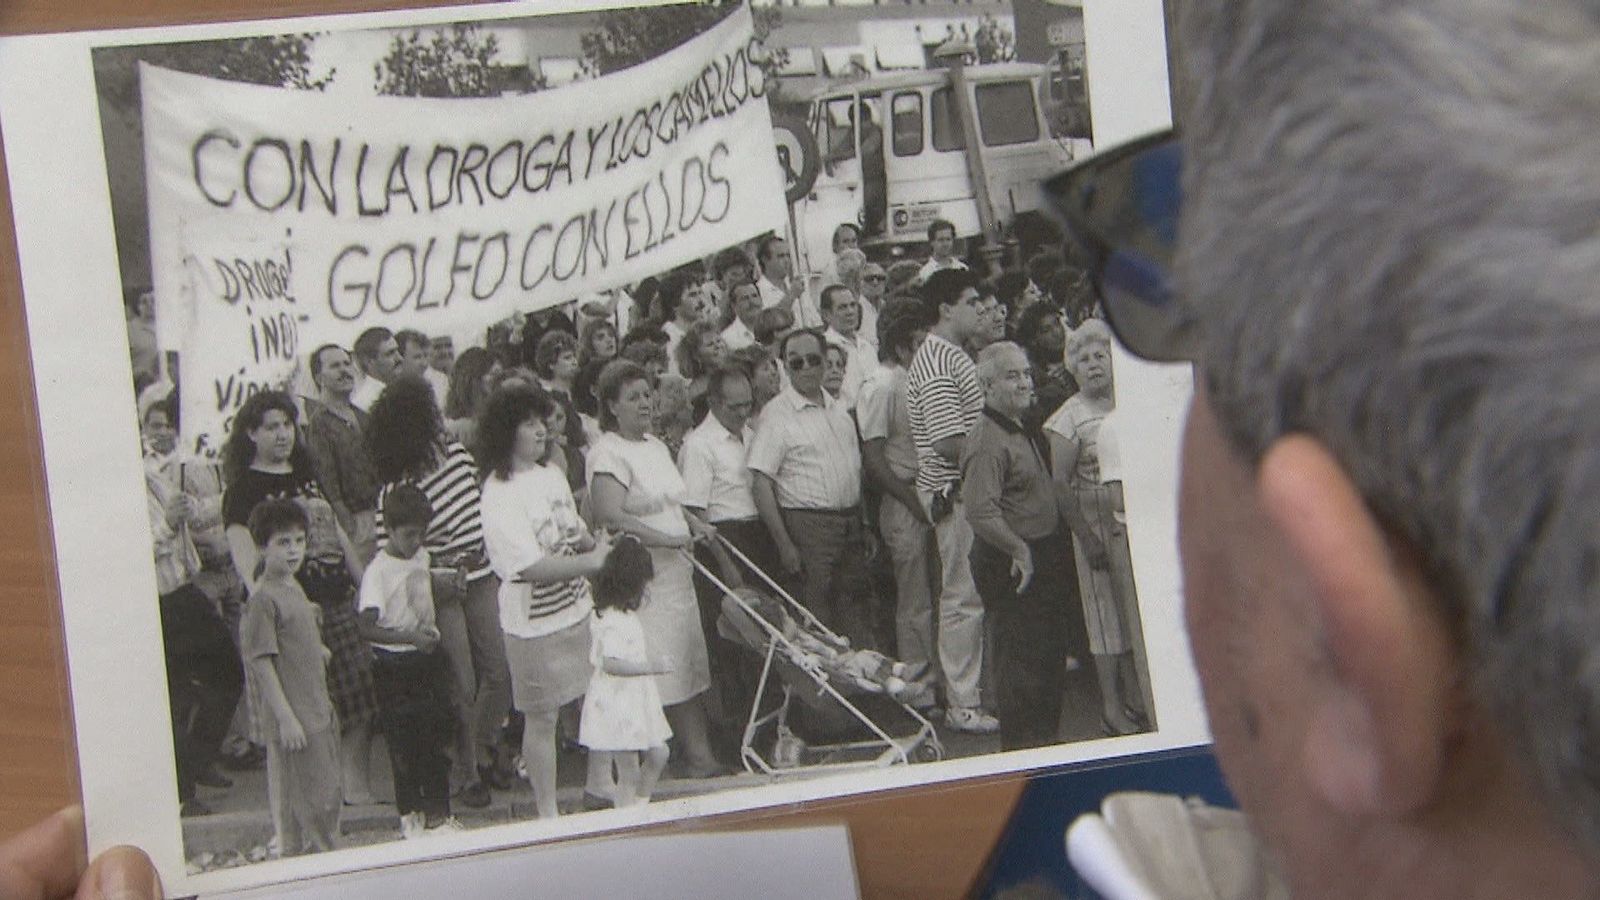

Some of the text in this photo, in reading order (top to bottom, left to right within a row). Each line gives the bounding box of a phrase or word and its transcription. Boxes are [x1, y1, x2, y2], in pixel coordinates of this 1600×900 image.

[192, 36, 767, 217] CON LA DROGA Y LOS CAMELLOS
[327, 141, 731, 322] GOLFO CON ELLOS
